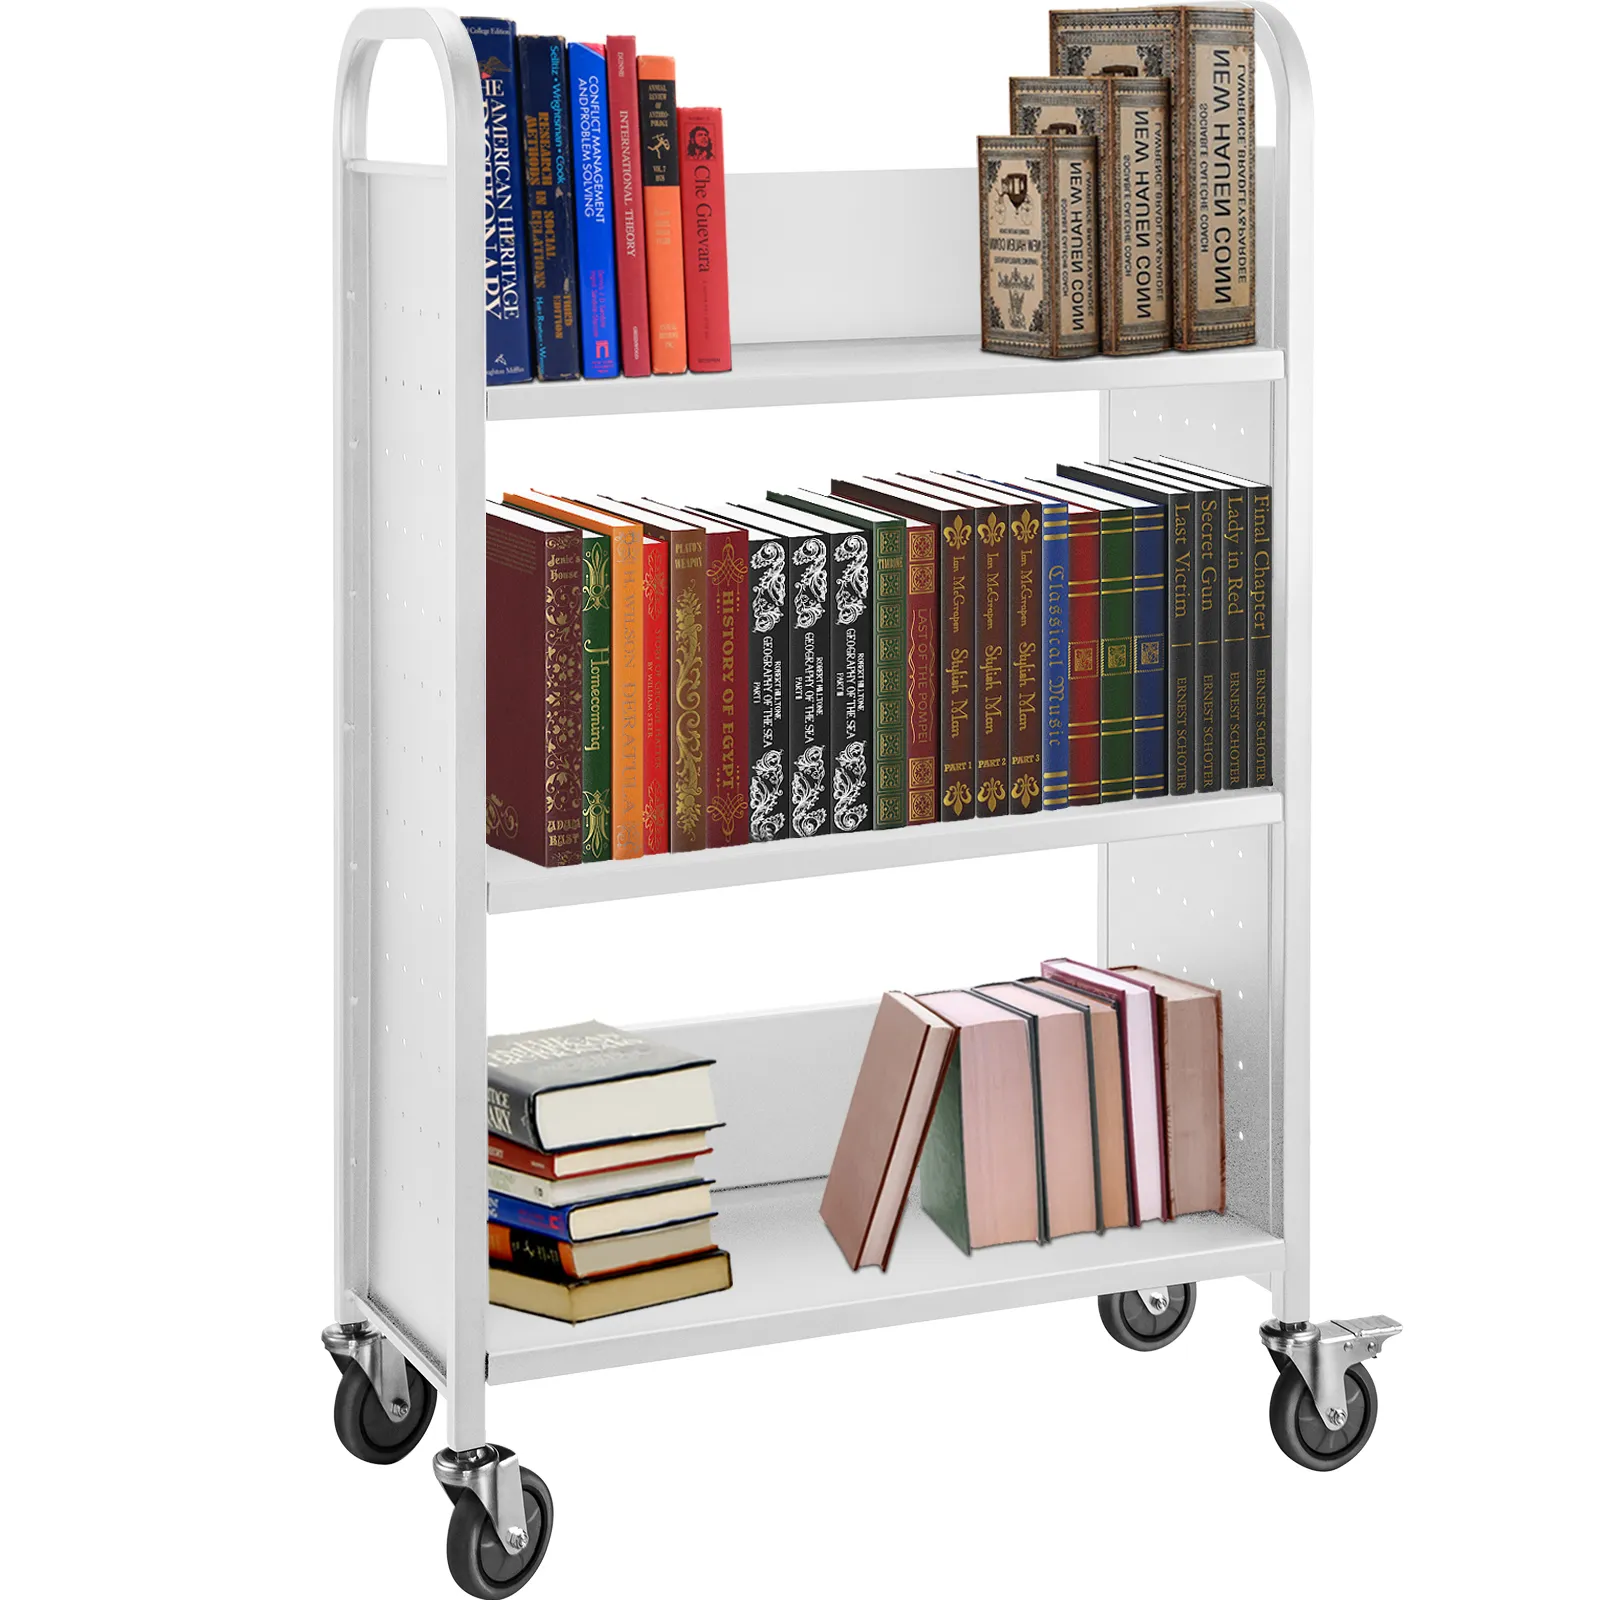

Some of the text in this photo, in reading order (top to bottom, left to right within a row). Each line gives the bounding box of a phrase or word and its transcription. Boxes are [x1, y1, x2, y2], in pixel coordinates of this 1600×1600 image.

[481, 79, 505, 97] HE
[550, 83, 563, 147] Wrightsman
[526, 115, 541, 186] METHODS
[538, 112, 552, 186] RESEARCH
[555, 155, 566, 184] Cook
[582, 163, 595, 218] SOLVING
[588, 75, 605, 224] CONFLICT MANAGEMENT
[619, 110, 636, 257] INTERNATIONAL THEORY
[694, 165, 711, 199] Che
[490, 98, 520, 320] AMERICAN HERITAGE
[535, 190, 547, 205] IN
[543, 210, 556, 260] SOCIAL
[695, 203, 713, 273] Guevara
[531, 210, 546, 289] RELATIONS
[953, 555, 966, 573] Ian
[987, 552, 999, 569] Ian
[1021, 549, 1033, 567] Ian
[1174, 503, 1191, 619] Last Victim
[1201, 500, 1217, 612] Secret Gun
[1224, 495, 1244, 616] Lady in Red
[1250, 495, 1270, 630] Final Chapter
[584, 638, 609, 752] Homecoming
[648, 661, 653, 672] BY
[722, 591, 734, 789] HISTORY OF EGYPT
[753, 682, 761, 699] PART
[763, 636, 773, 748] GEOGRAPHY OF THE SEA
[795, 677, 803, 694] PART
[804, 632, 815, 744] GEOGRAPHY OF THE SEA
[836, 672, 844, 690] PART
[846, 628, 856, 739] GEOGRAPHY OF THE SEA
[917, 608, 929, 743] LAST OF THE POMPEI
[945, 648, 969, 739] Stylish Man
[979, 645, 1003, 735] Stylish Man
[1013, 642, 1036, 732] Stylish Man
[1048, 565, 1065, 747] Classical Music
[944, 762, 967, 773] PART
[978, 757, 1006, 769] PART 2
[1012, 754, 1040, 765] PART 3
[1176, 677, 1187, 791] ERNEST SCHOTER
[1203, 674, 1213, 788] ERNEST SCHOTER
[1230, 672, 1240, 785] ERNEST SCHOTER
[1256, 669, 1266, 782] ERNEST SCHOTER
